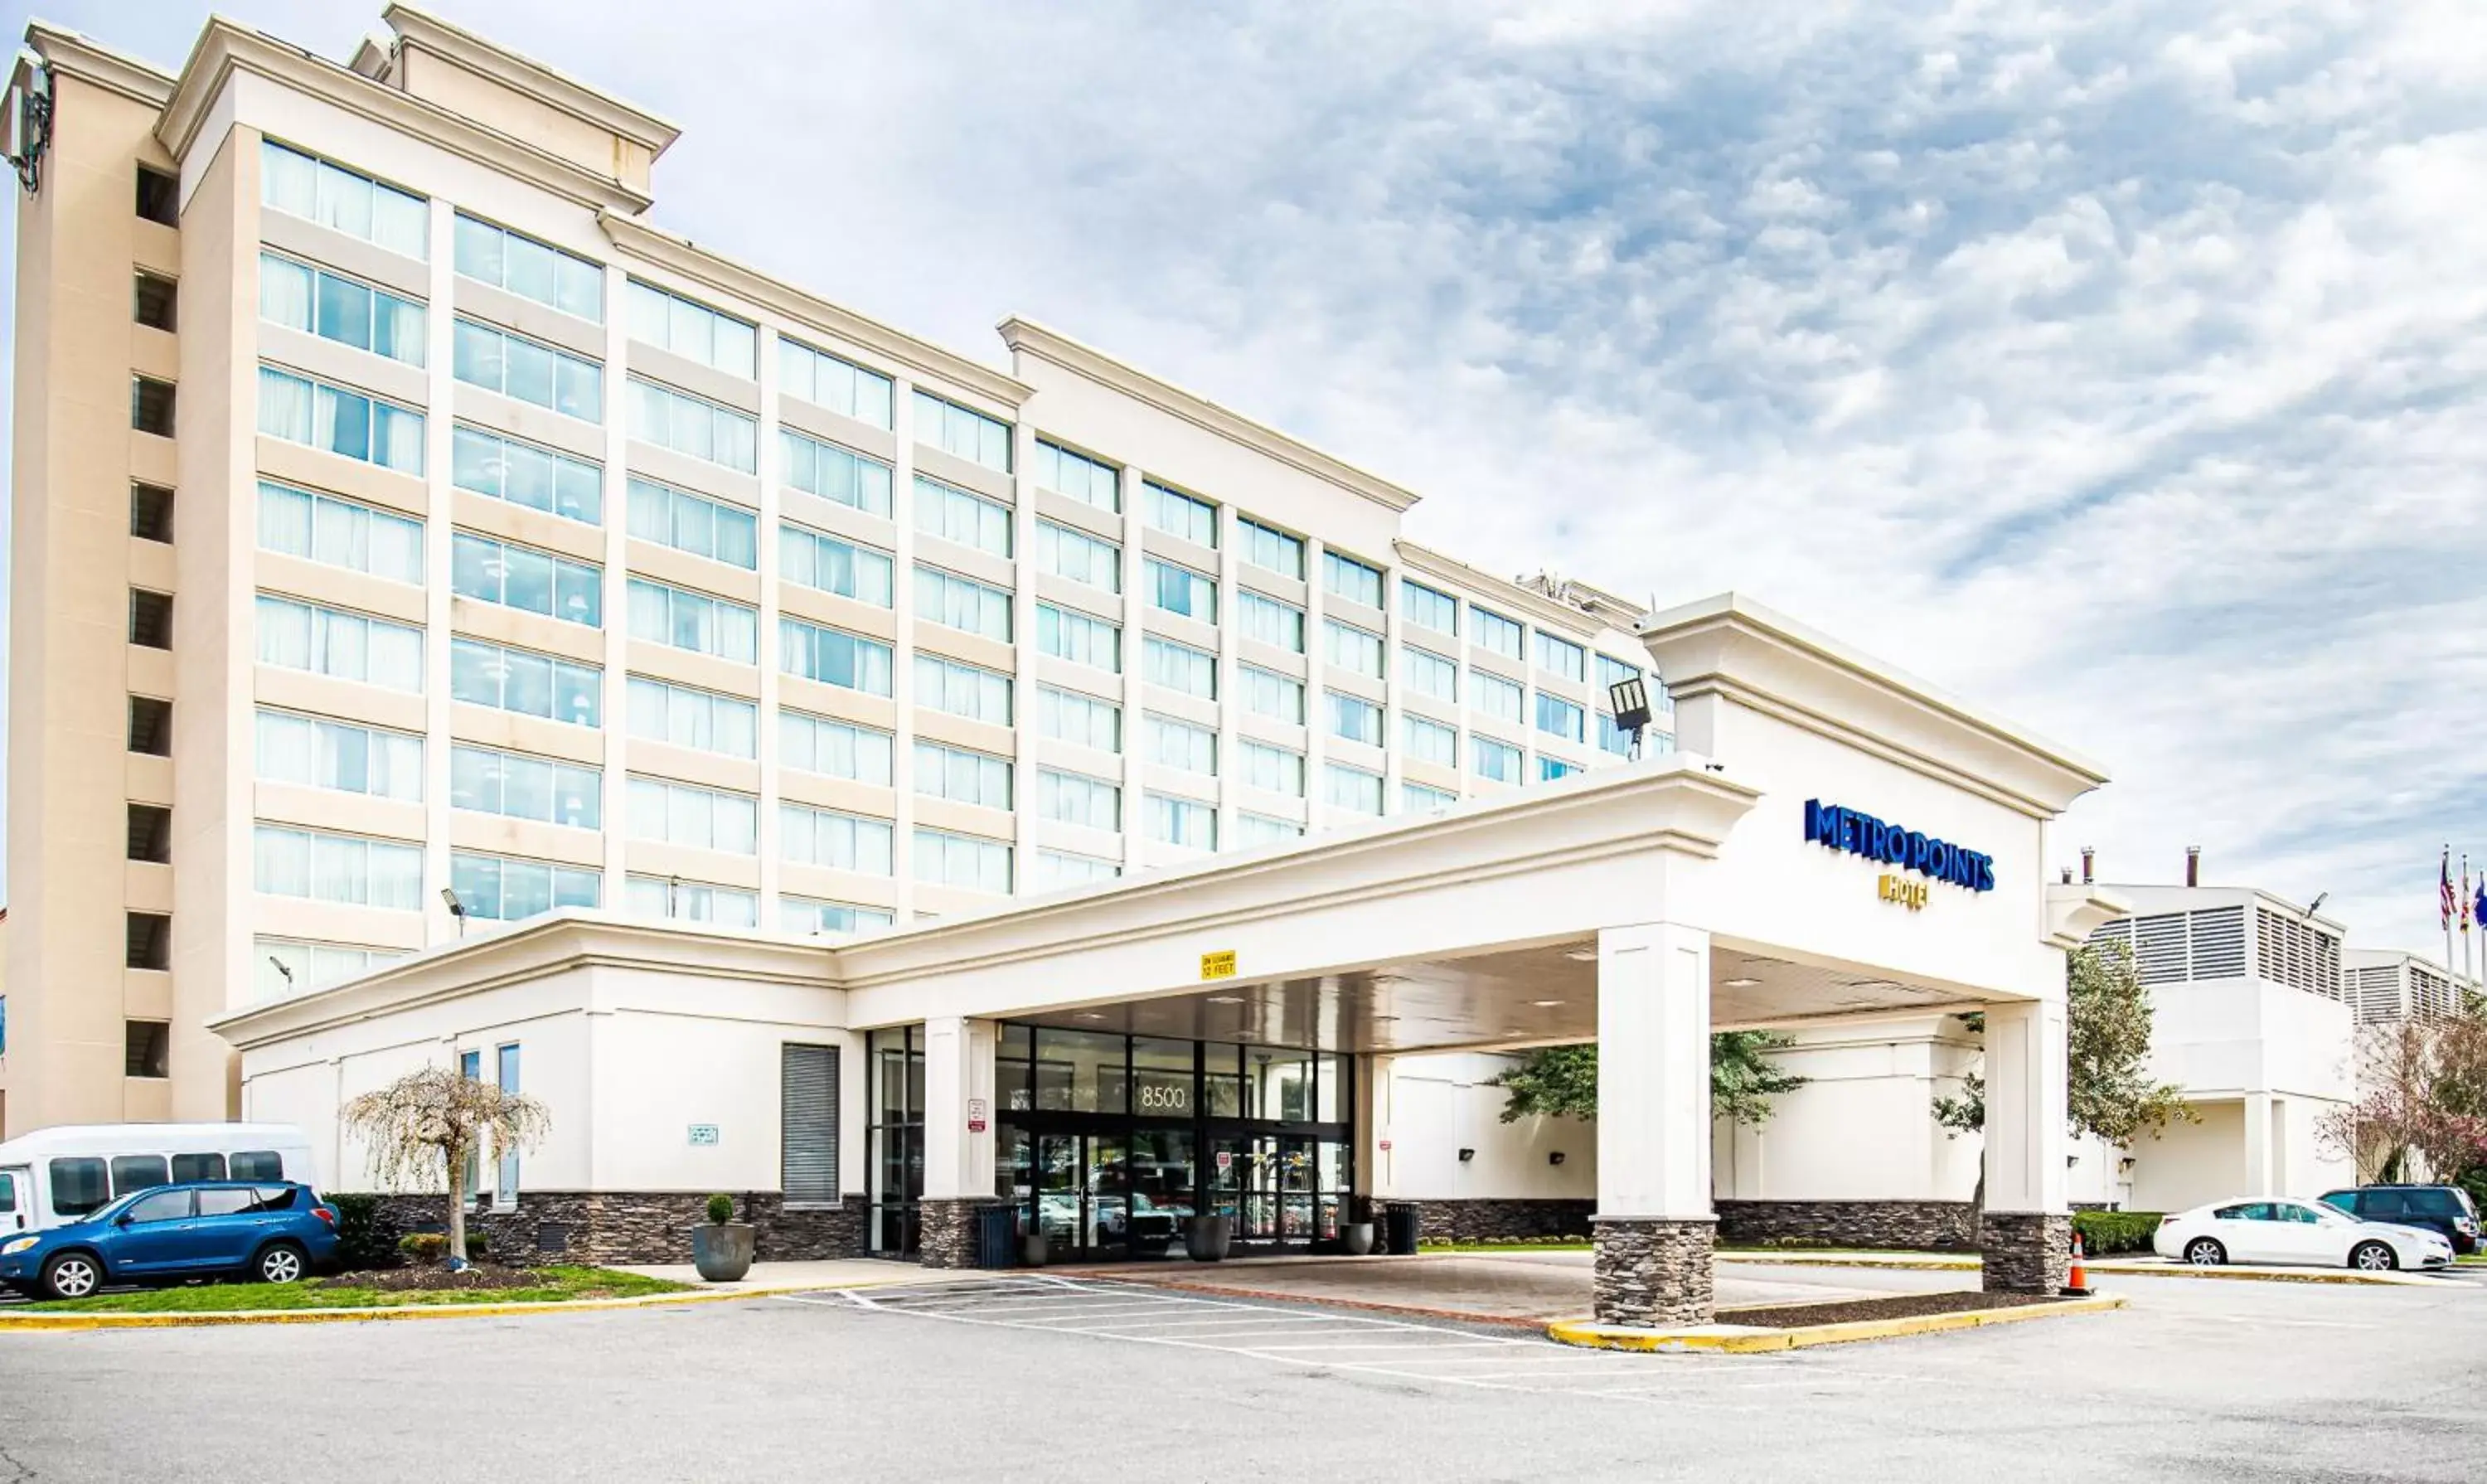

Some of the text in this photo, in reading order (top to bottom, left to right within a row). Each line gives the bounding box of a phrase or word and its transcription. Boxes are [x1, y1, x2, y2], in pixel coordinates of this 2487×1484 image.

[1805, 798, 1995, 892] METRO POINTS
[1142, 1086, 1185, 1108] 8500
